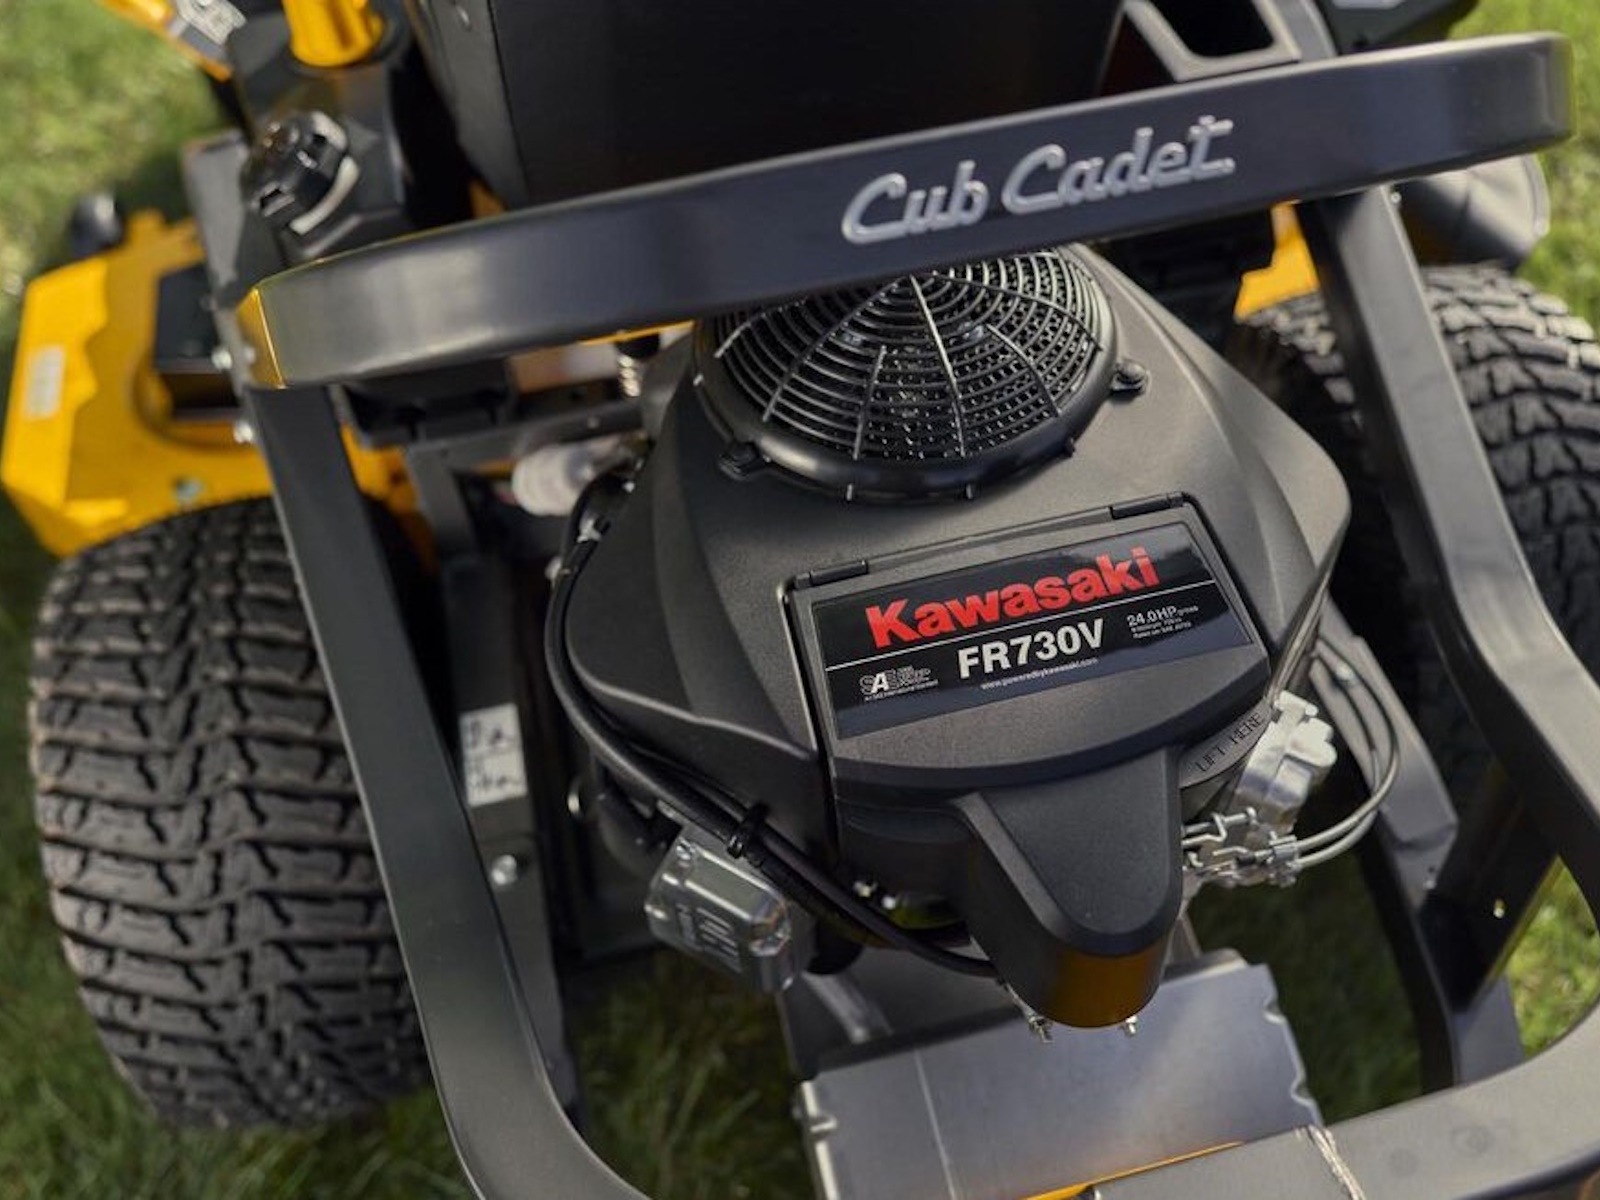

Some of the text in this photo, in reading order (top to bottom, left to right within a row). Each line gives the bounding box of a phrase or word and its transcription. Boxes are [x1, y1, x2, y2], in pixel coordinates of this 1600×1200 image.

[841, 114, 1236, 244] Cub Cadet
[865, 546, 1161, 648] Kawasaki
[957, 618, 1104, 679] FR730V
